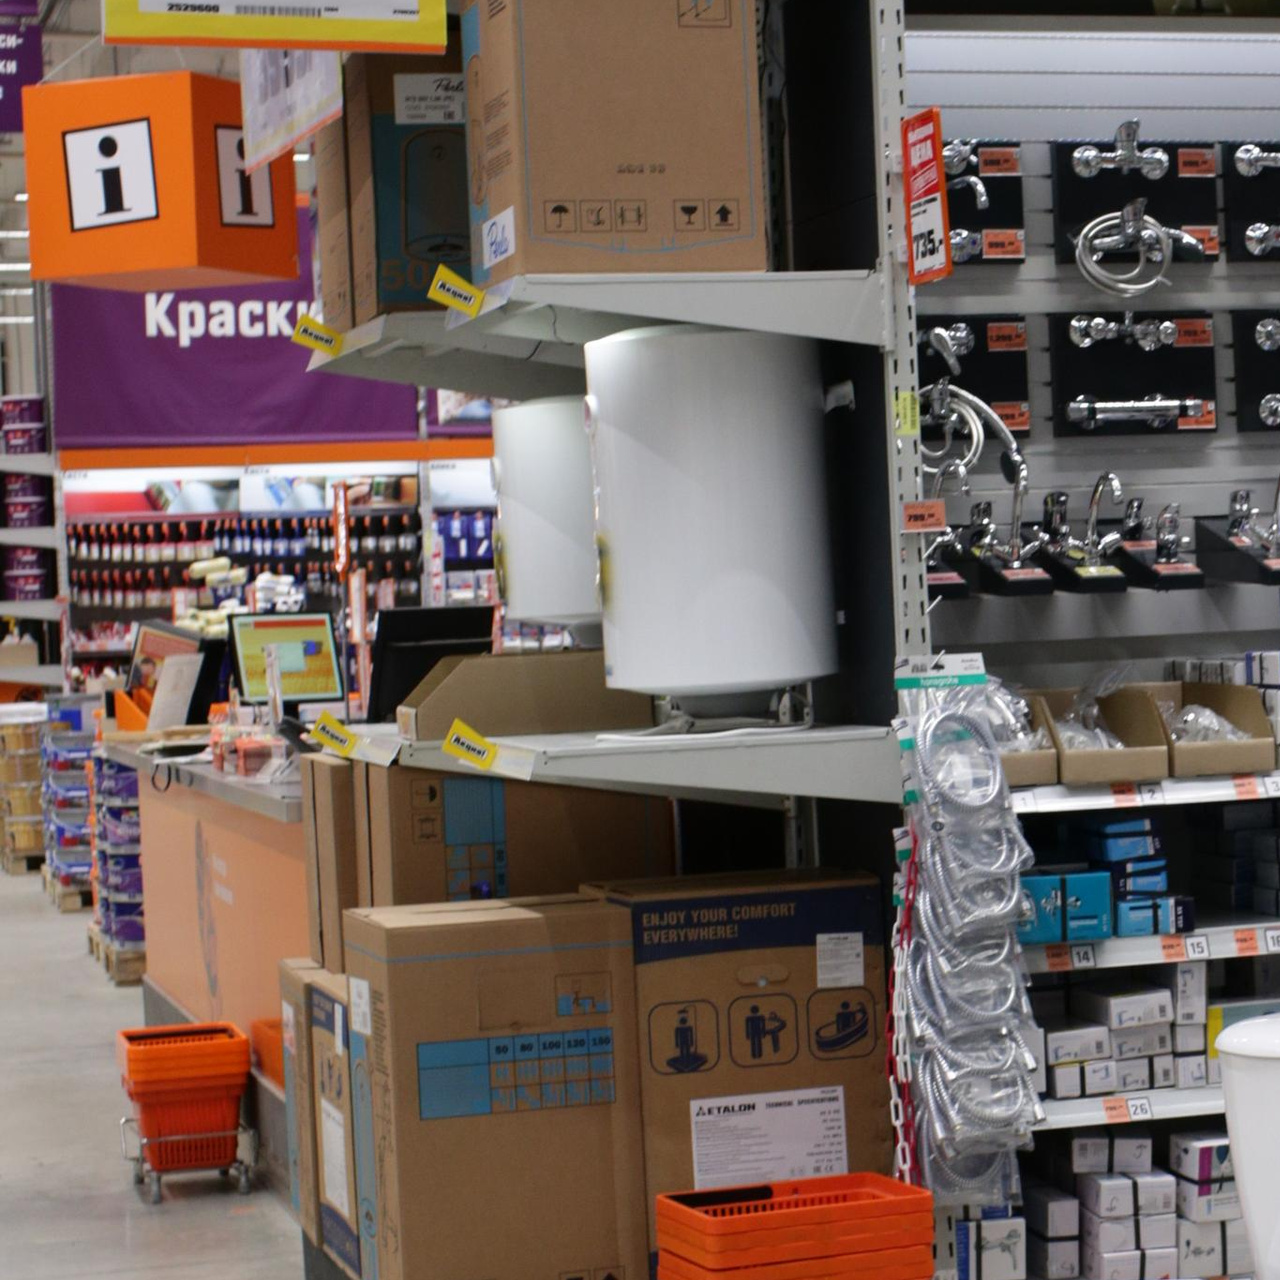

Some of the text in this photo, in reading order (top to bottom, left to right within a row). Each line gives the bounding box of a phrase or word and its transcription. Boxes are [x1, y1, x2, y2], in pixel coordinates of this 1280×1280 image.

[642, 902, 796, 927] ENJOY YOUR COMFORT
[643, 925, 738, 945] EVERYWHERE!
[1190, 940, 1204, 955] 15
[1075, 949, 1090, 963] 14
[707, 1102, 756, 1116] ETALON
[1132, 1102, 1148, 1116] 26
